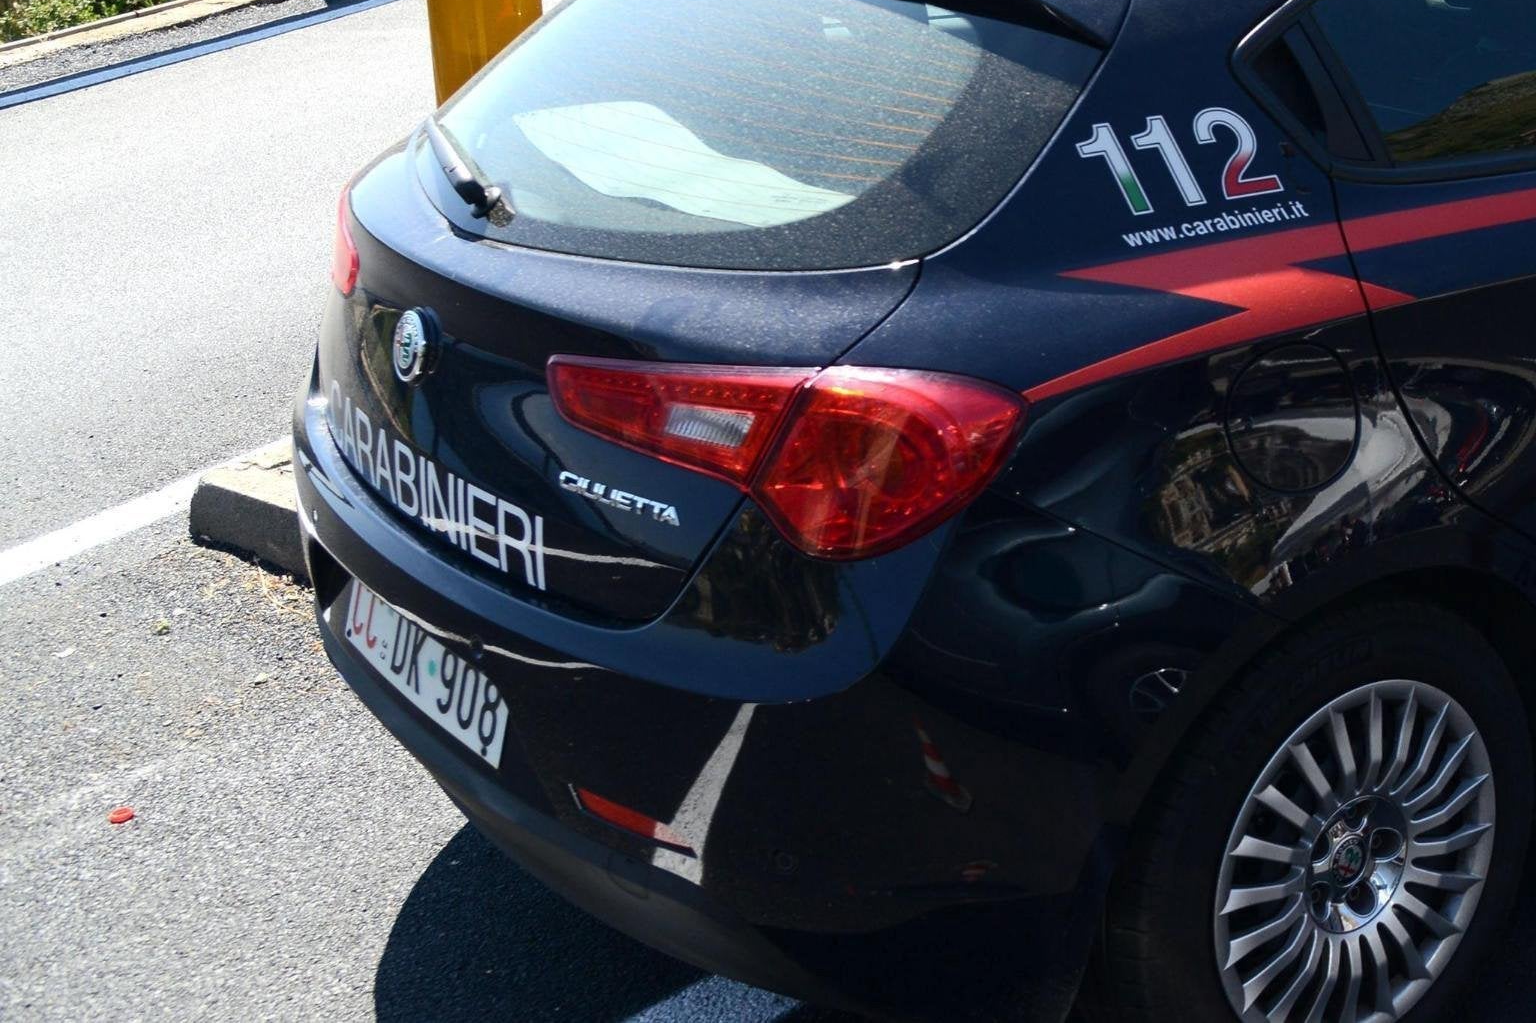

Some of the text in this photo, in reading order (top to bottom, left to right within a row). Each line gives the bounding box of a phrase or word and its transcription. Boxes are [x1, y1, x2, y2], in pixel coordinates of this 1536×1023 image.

[1075, 107, 1284, 216] 112
[1122, 201, 1309, 248] www.carabinieri.it
[332, 380, 546, 591] CARABINIERI
[559, 470, 680, 527] GIULIETTA
[436, 646, 502, 748] 908
